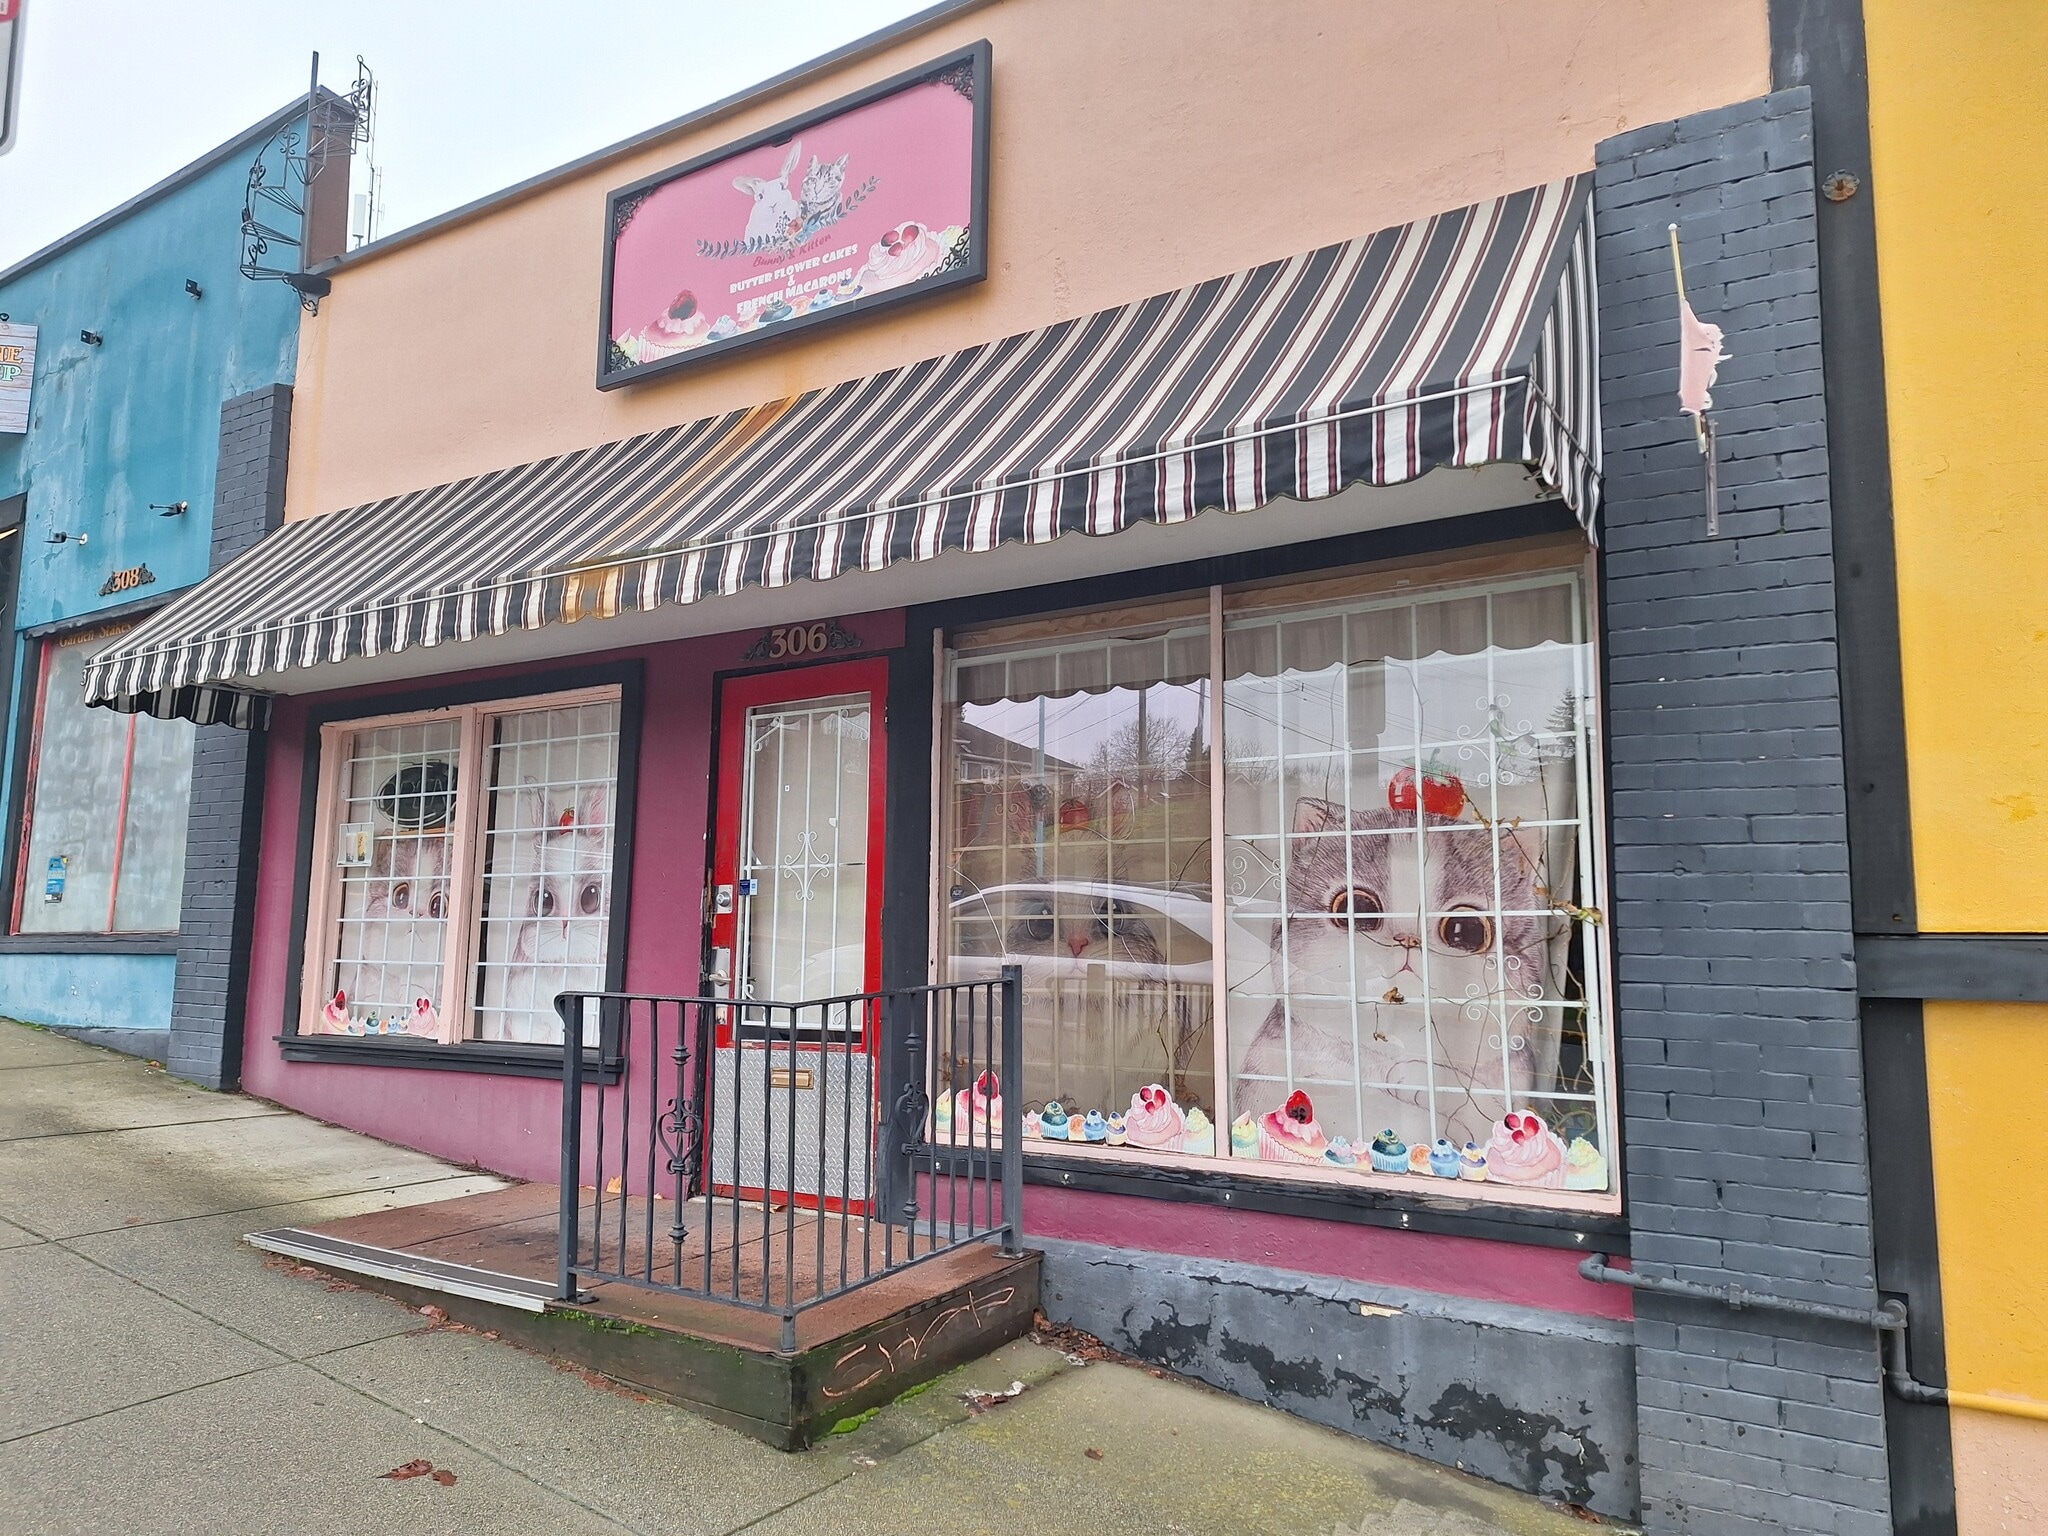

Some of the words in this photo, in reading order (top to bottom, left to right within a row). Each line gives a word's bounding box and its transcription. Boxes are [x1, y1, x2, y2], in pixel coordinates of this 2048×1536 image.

[729, 272, 772, 294] BUTTER
[774, 257, 821, 280] FLOWER
[822, 243, 858, 264] CAKES
[753, 254, 786, 267] Bunny
[786, 248, 796, 260] &
[736, 289, 784, 314] FRENCH
[785, 267, 853, 299] MACARONS
[787, 274, 796, 287] &
[112, 566, 140, 592] 308
[769, 622, 827, 658] 306
